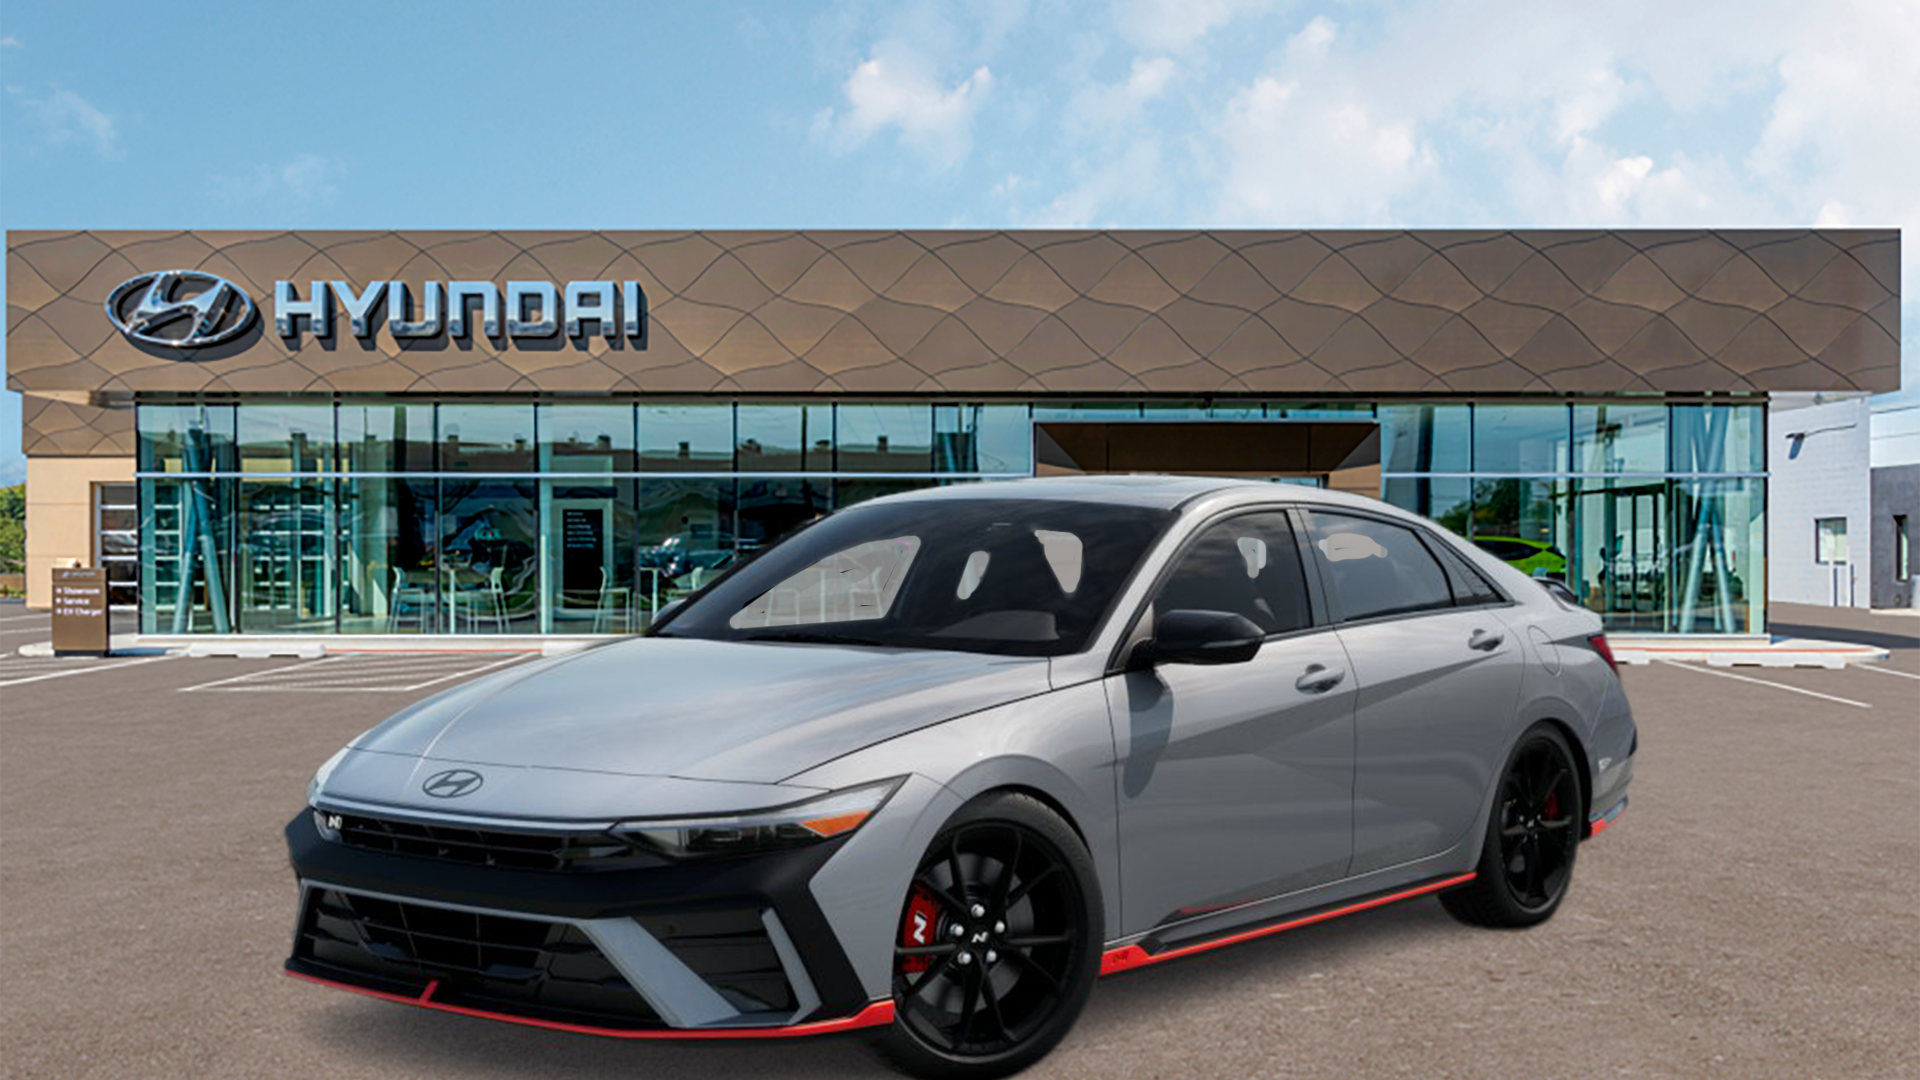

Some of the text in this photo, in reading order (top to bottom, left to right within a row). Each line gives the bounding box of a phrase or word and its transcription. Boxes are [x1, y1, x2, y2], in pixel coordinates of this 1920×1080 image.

[274, 280, 640, 338] HYUNDAI
[63, 587, 100, 595] Showroom
[75, 608, 102, 617] Charger
